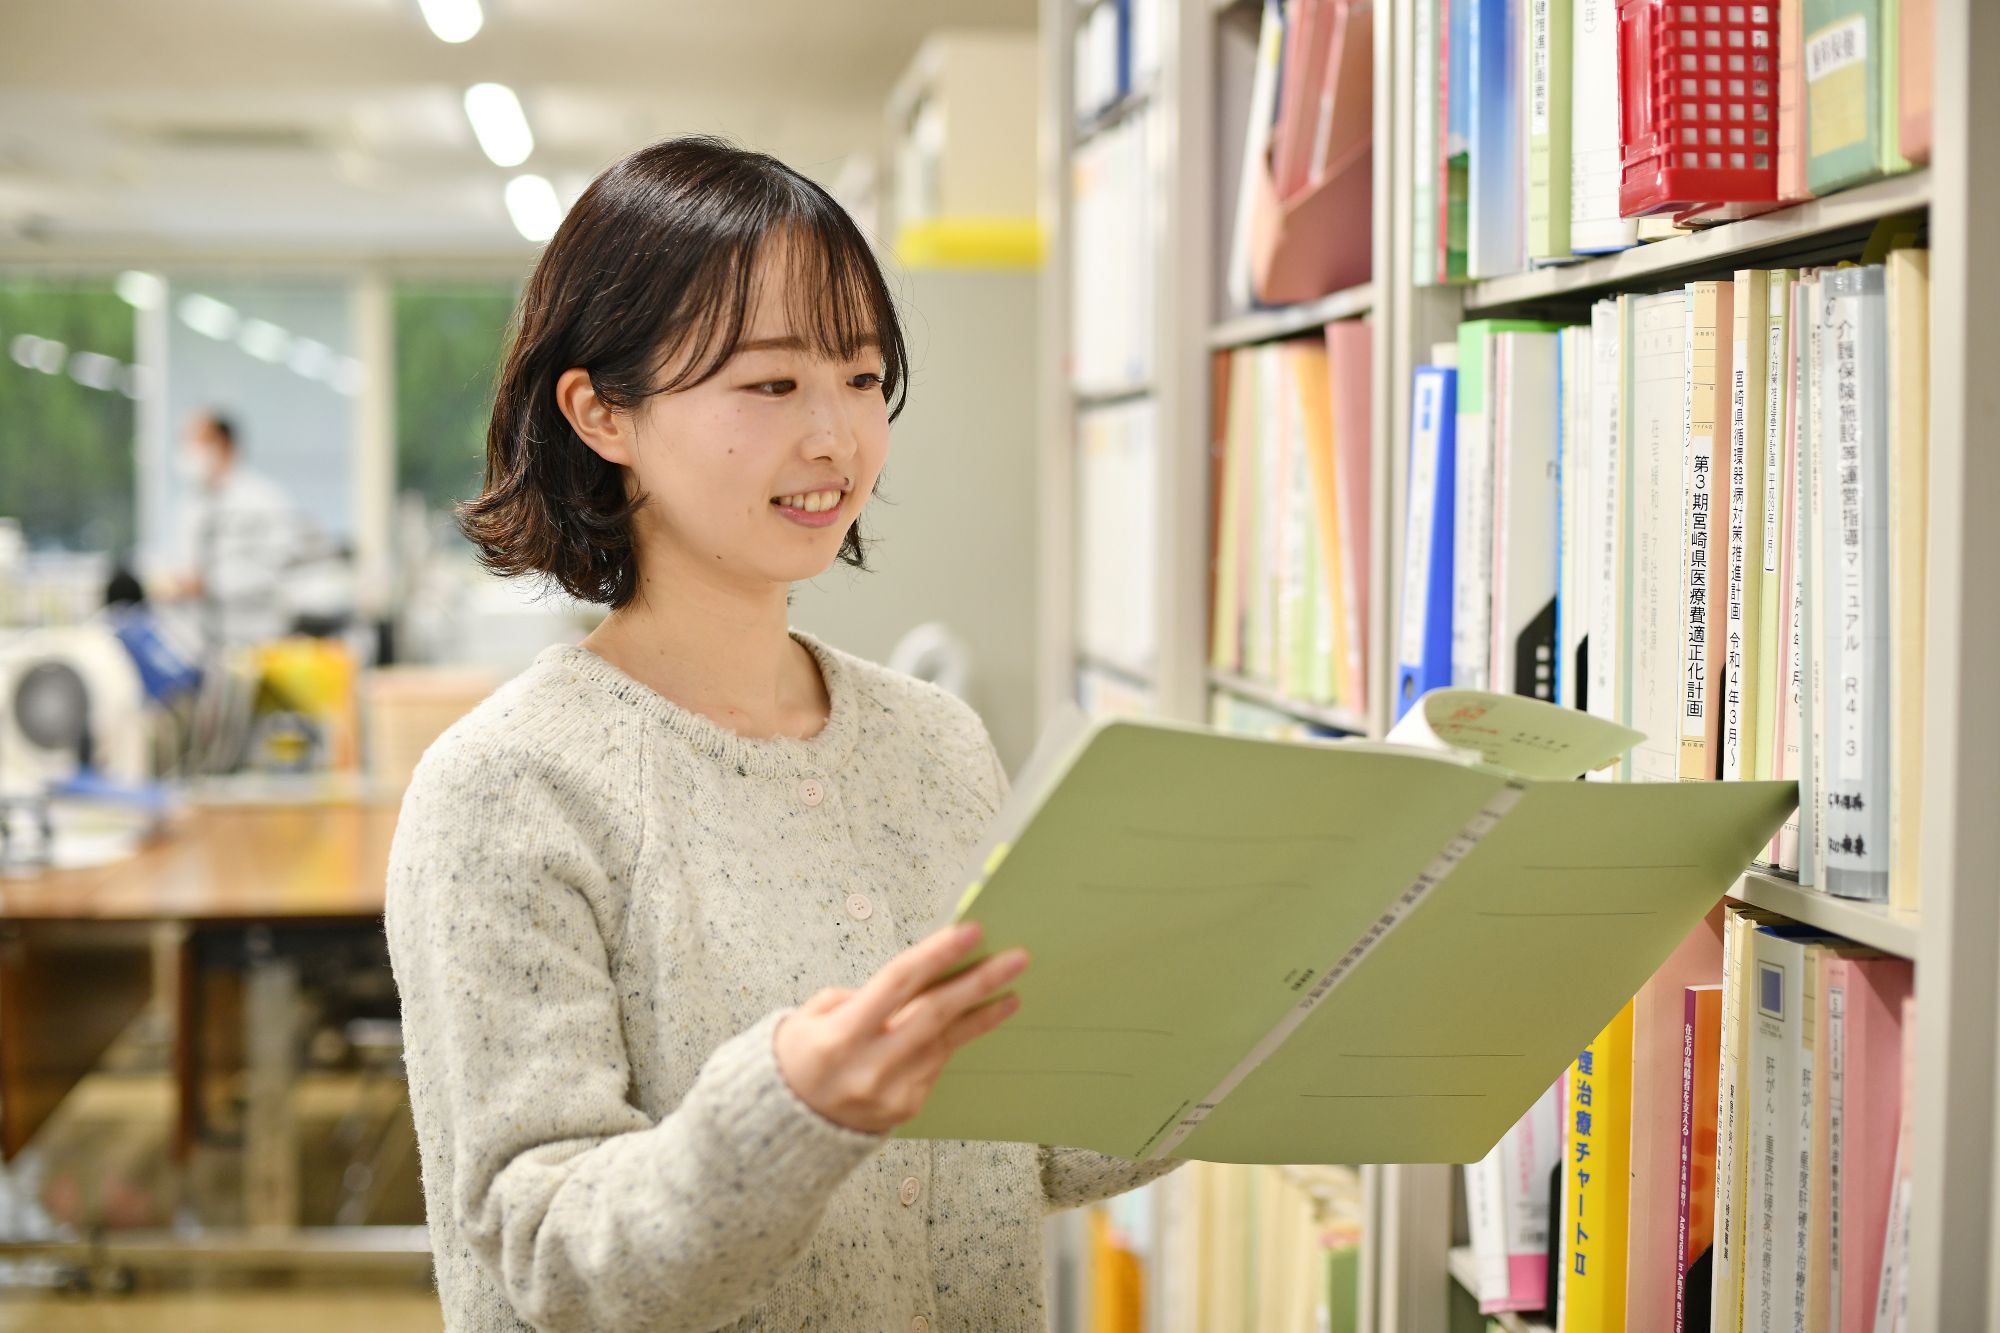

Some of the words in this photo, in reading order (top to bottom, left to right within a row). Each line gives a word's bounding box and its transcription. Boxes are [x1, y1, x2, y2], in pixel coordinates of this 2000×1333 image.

[1686, 455, 1710, 718] 第3期宮崎県医療費適正化計画
[1731, 370, 1744, 620] 宮崎県循環器病対策推進計画
[1682, 1023, 1694, 1137] 在宅の高齢者を支える
[1761, 1055, 1776, 1333] 肝がん・重度肝硬変治療研究促
[1794, 1066, 1812, 1333] 肝がん・重度肝硬変治療研究
[1678, 1215, 1686, 1261] Advances
